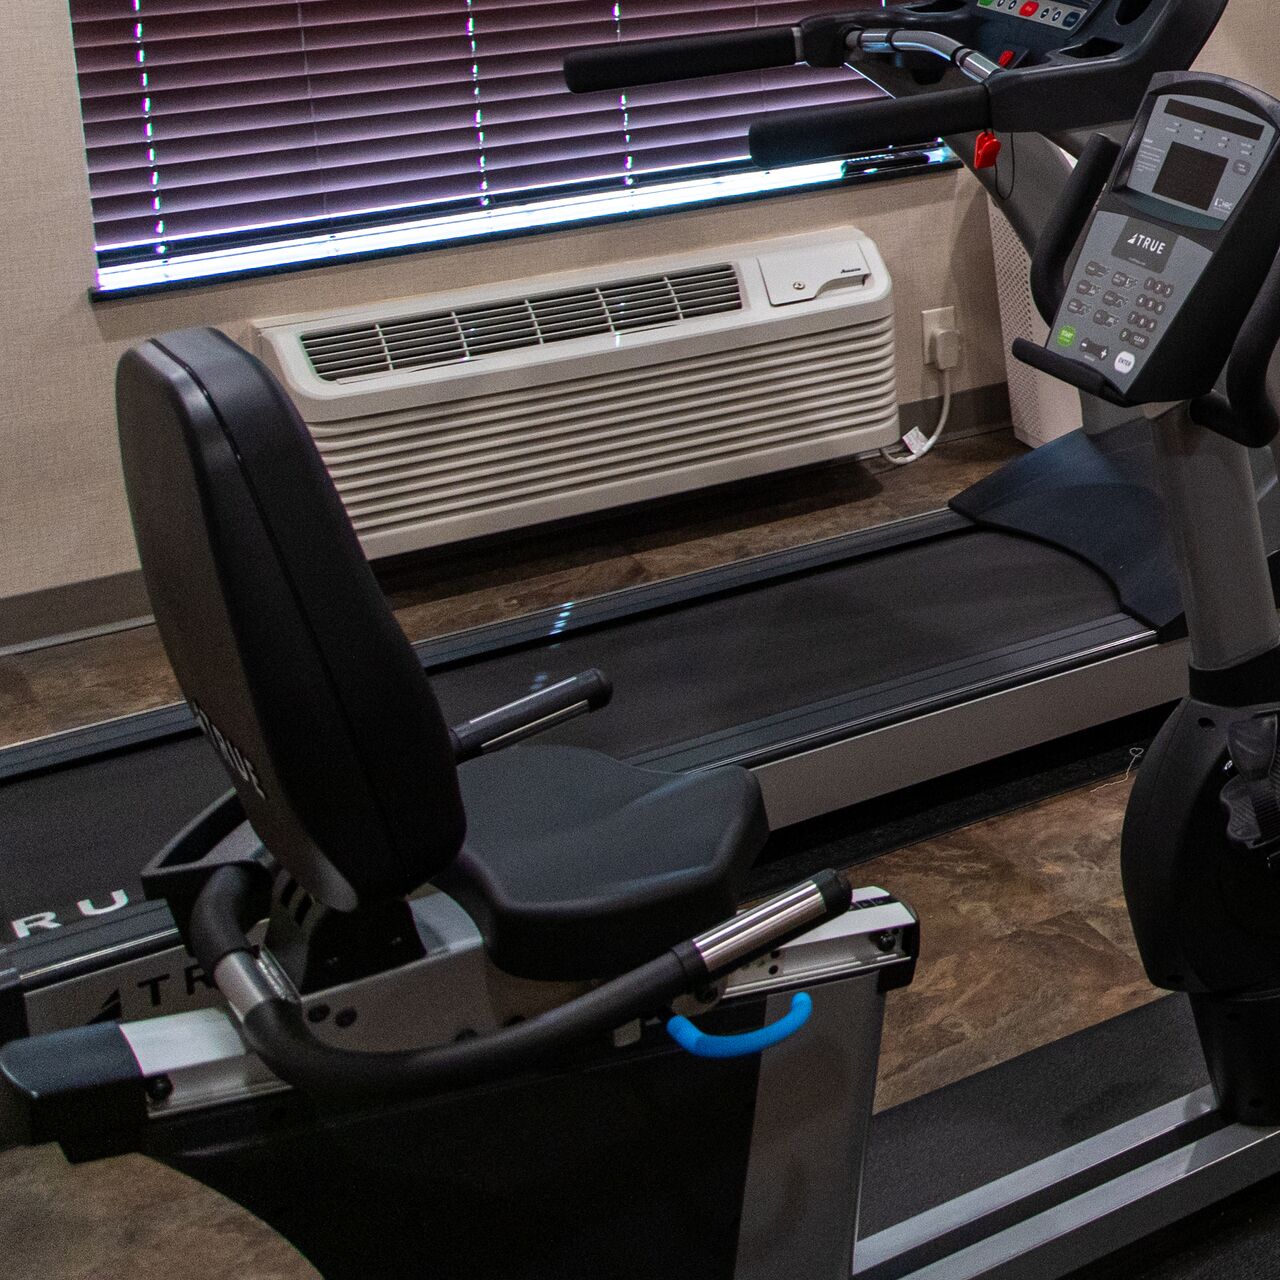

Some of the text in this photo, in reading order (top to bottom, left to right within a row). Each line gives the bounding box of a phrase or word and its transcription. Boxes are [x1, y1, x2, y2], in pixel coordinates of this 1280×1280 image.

[1137, 233, 1166, 255] TRUE
[11, 888, 129, 939] RU
[137, 964, 217, 1007] TR
